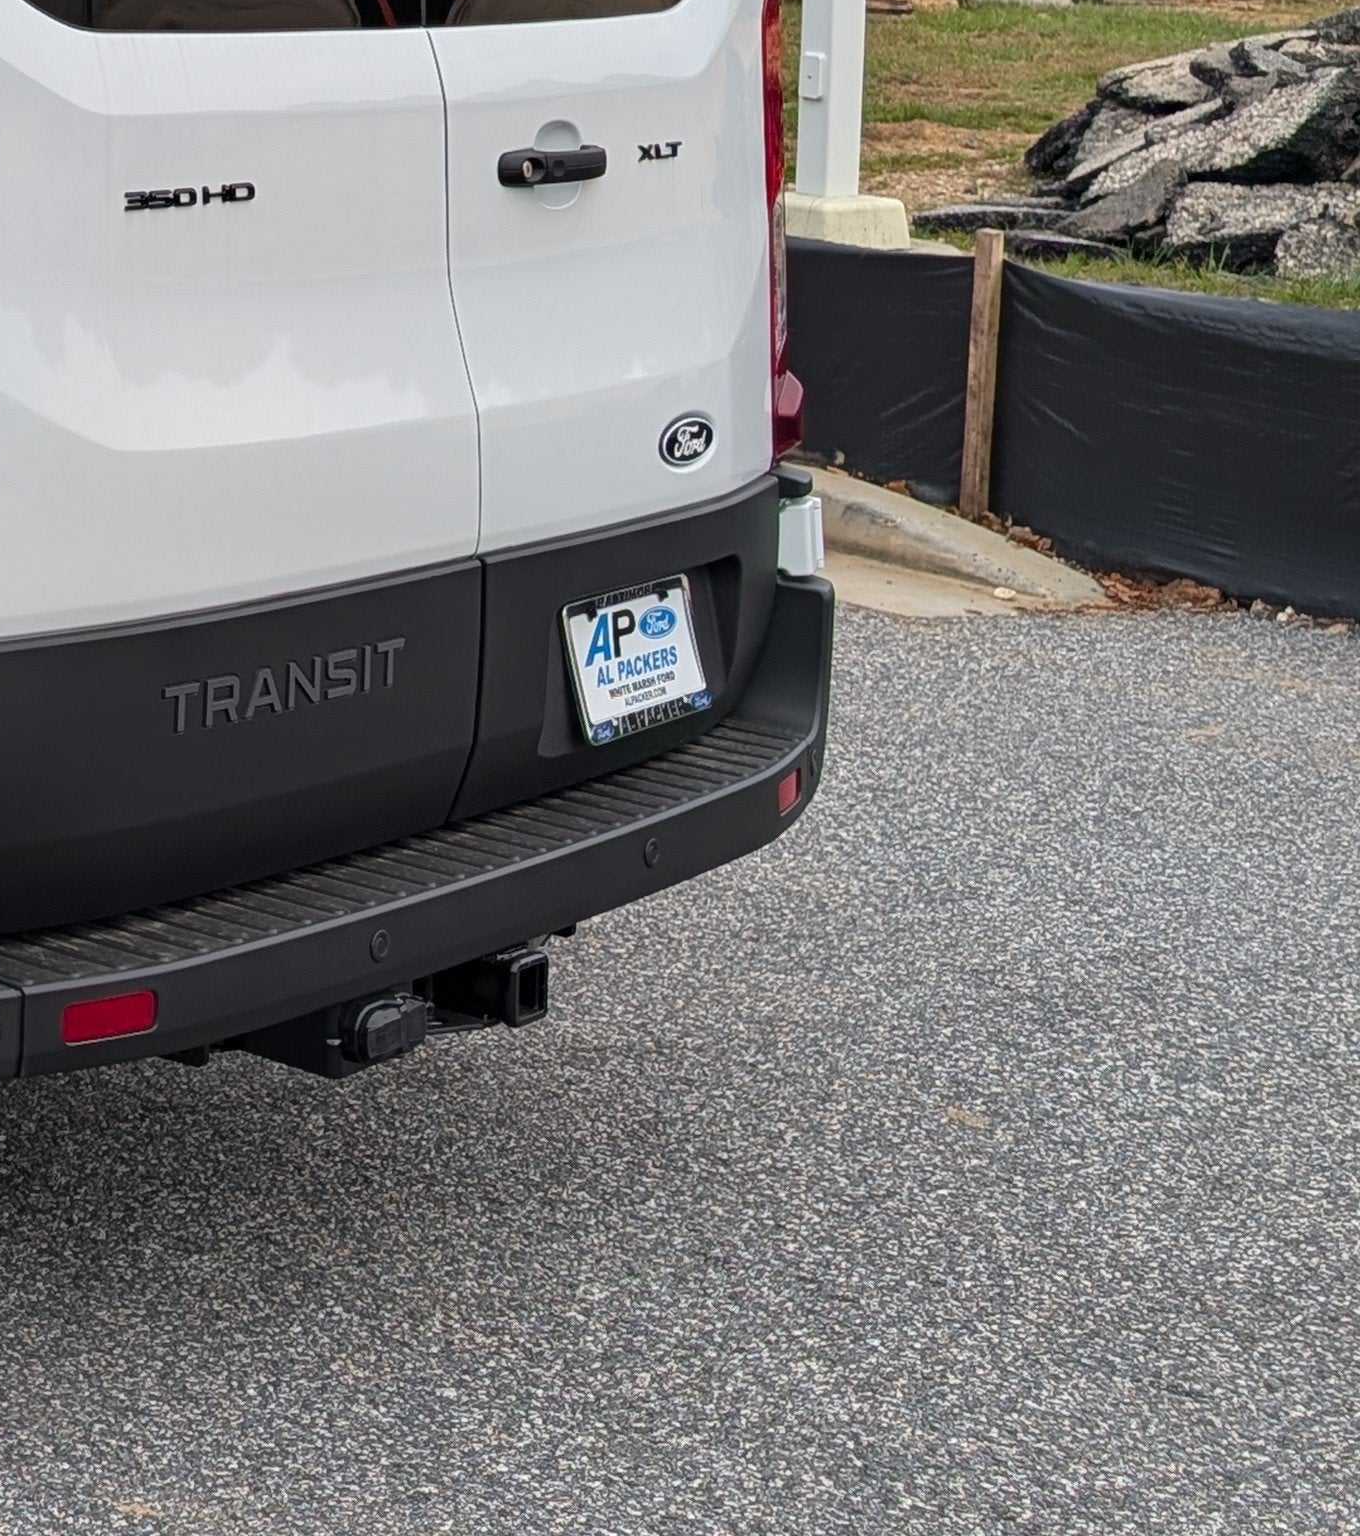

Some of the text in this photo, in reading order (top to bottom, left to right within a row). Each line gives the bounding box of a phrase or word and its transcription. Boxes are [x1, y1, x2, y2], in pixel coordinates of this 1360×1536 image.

[637, 141, 683, 163] XLT
[124, 182, 256, 212] 350 HD
[585, 608, 636, 668] AP
[597, 645, 678, 688] AL PACKERS
[608, 670, 676, 699] WHITE MARSH FORD
[161, 636, 406, 735] TRANSIT
